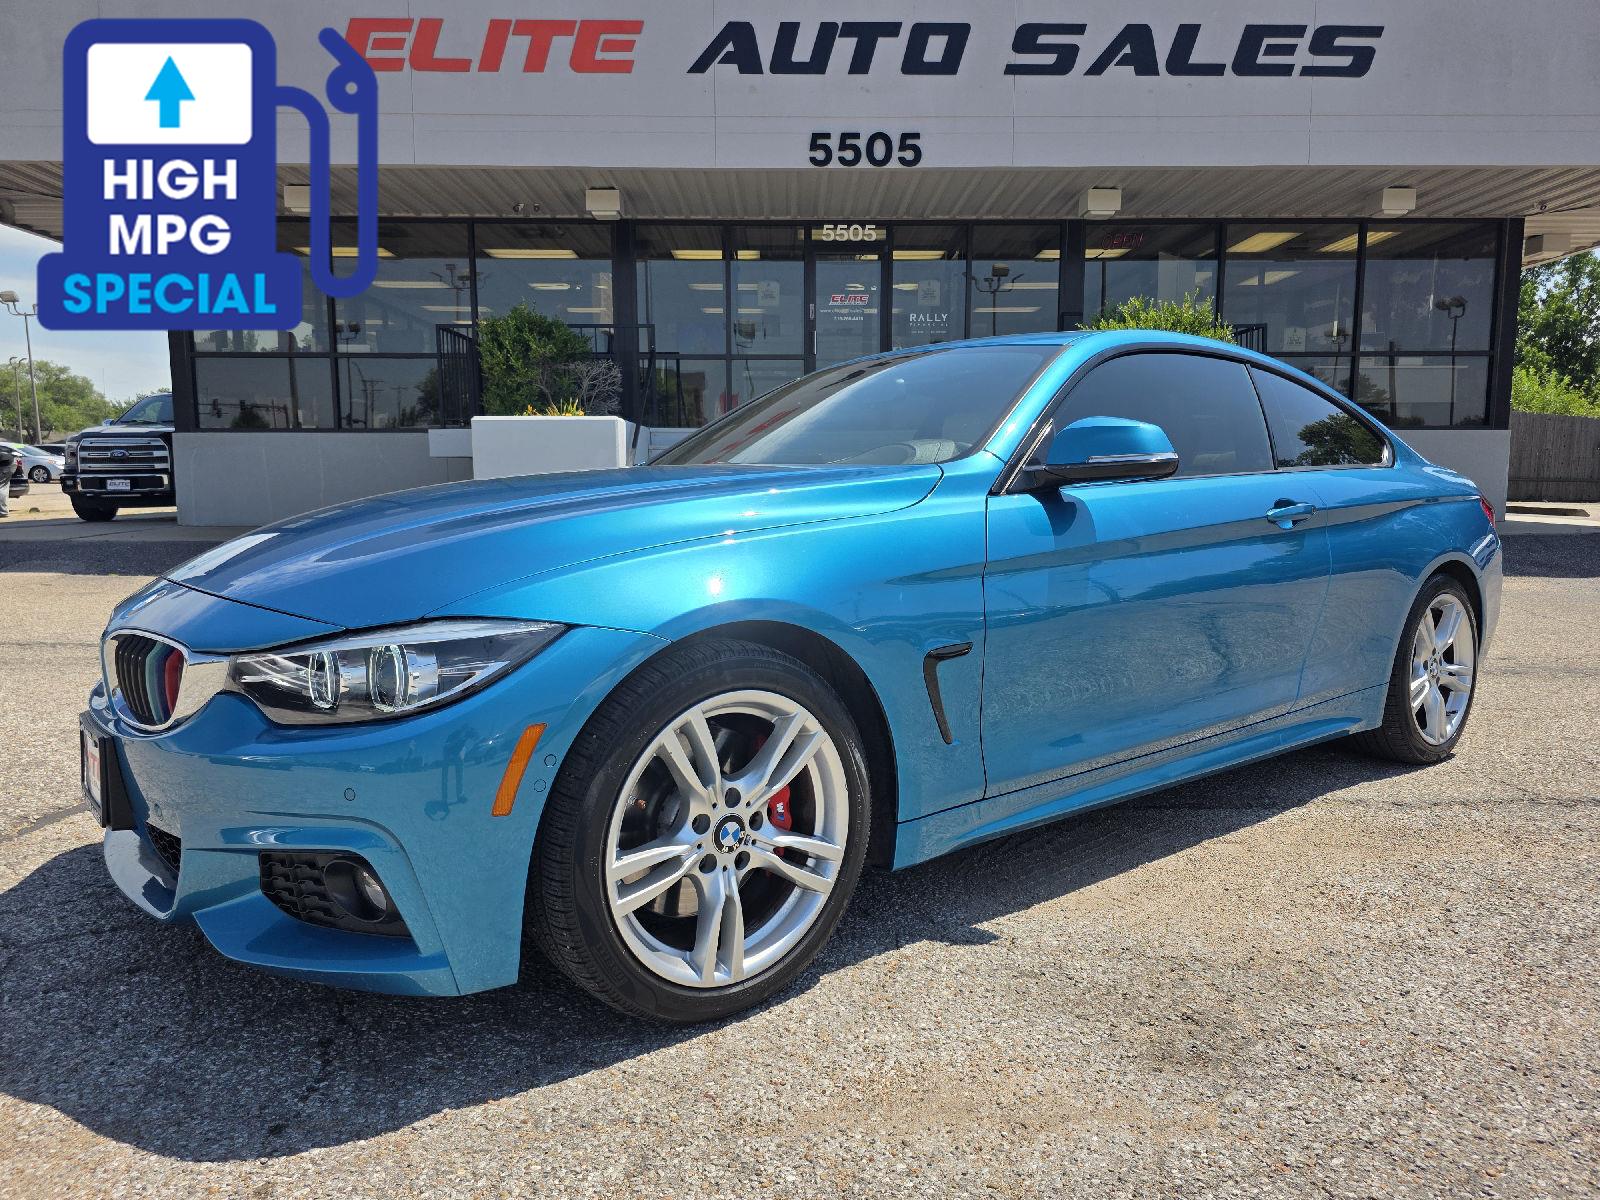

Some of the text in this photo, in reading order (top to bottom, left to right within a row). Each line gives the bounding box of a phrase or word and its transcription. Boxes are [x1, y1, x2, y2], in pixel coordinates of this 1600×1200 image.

[345, 18, 1384, 77] ELITE AUTO SALES
[809, 132, 922, 167] 5505
[822, 224, 876, 241] 5505
[910, 313, 948, 322] RALLY
